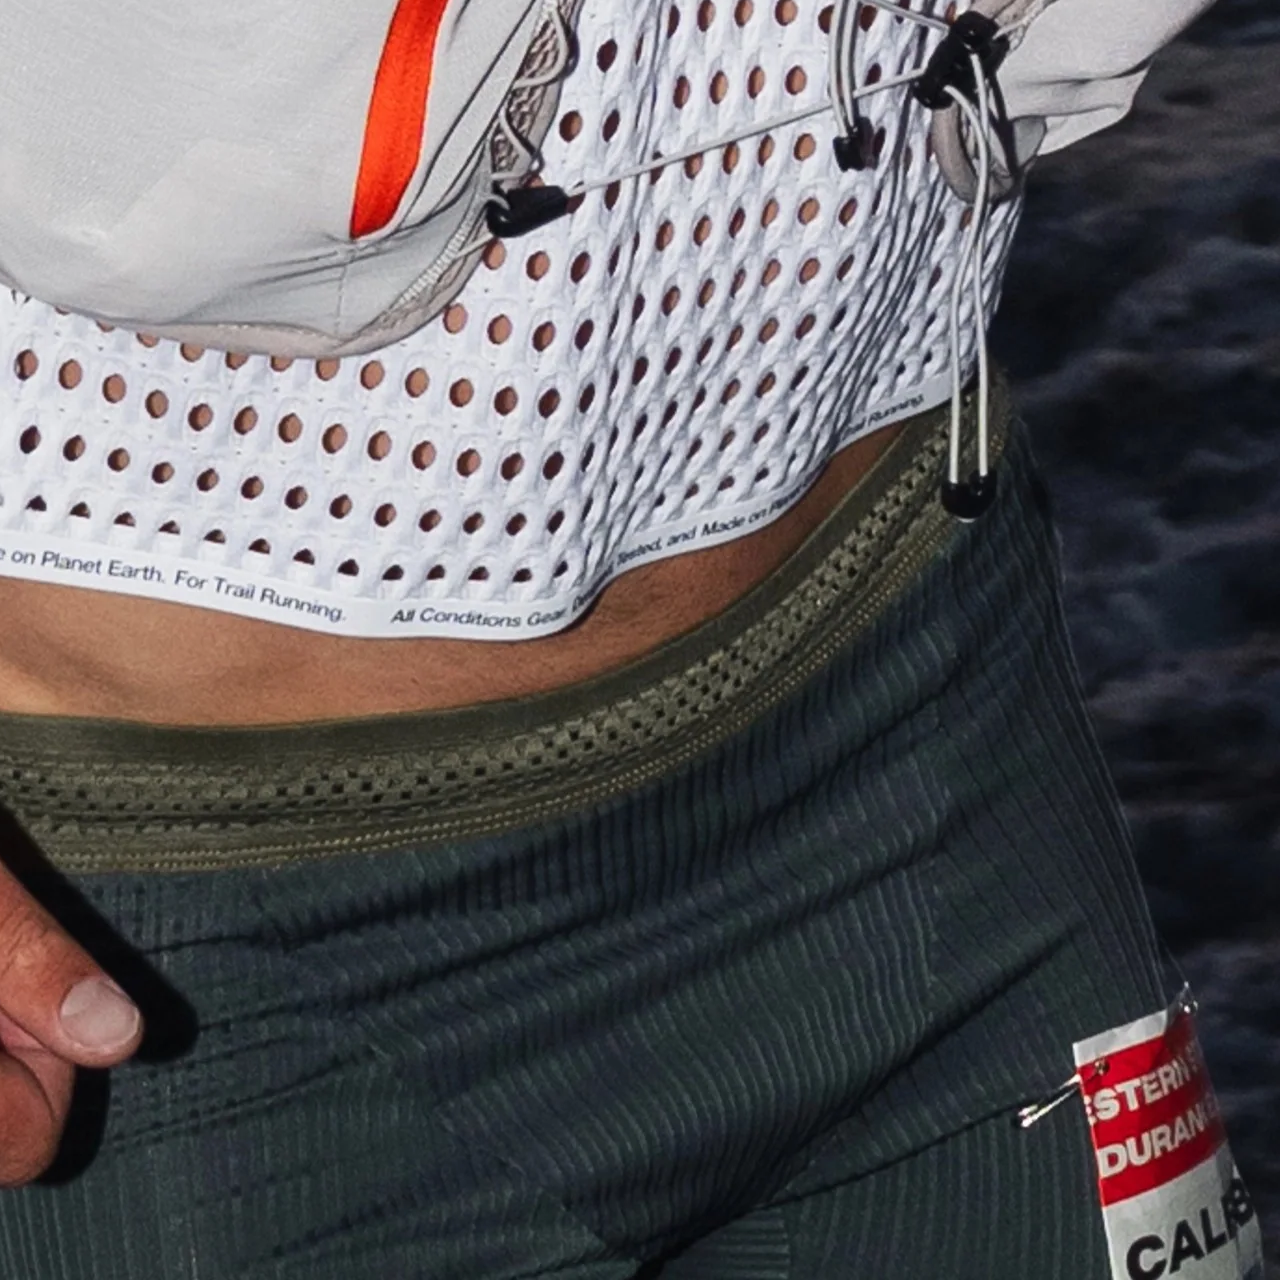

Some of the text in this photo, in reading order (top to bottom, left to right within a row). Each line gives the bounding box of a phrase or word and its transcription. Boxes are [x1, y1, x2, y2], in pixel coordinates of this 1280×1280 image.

[701, 515, 746, 537] Made
[10, 550, 36, 566] on
[40, 550, 102, 574] Planet
[107, 559, 166, 584] Earth.
[173, 569, 209, 590] For
[213, 576, 256, 601] Trail
[259, 587, 347, 623] Running.
[390, 608, 415, 624] All
[419, 607, 521, 628] Conditions
